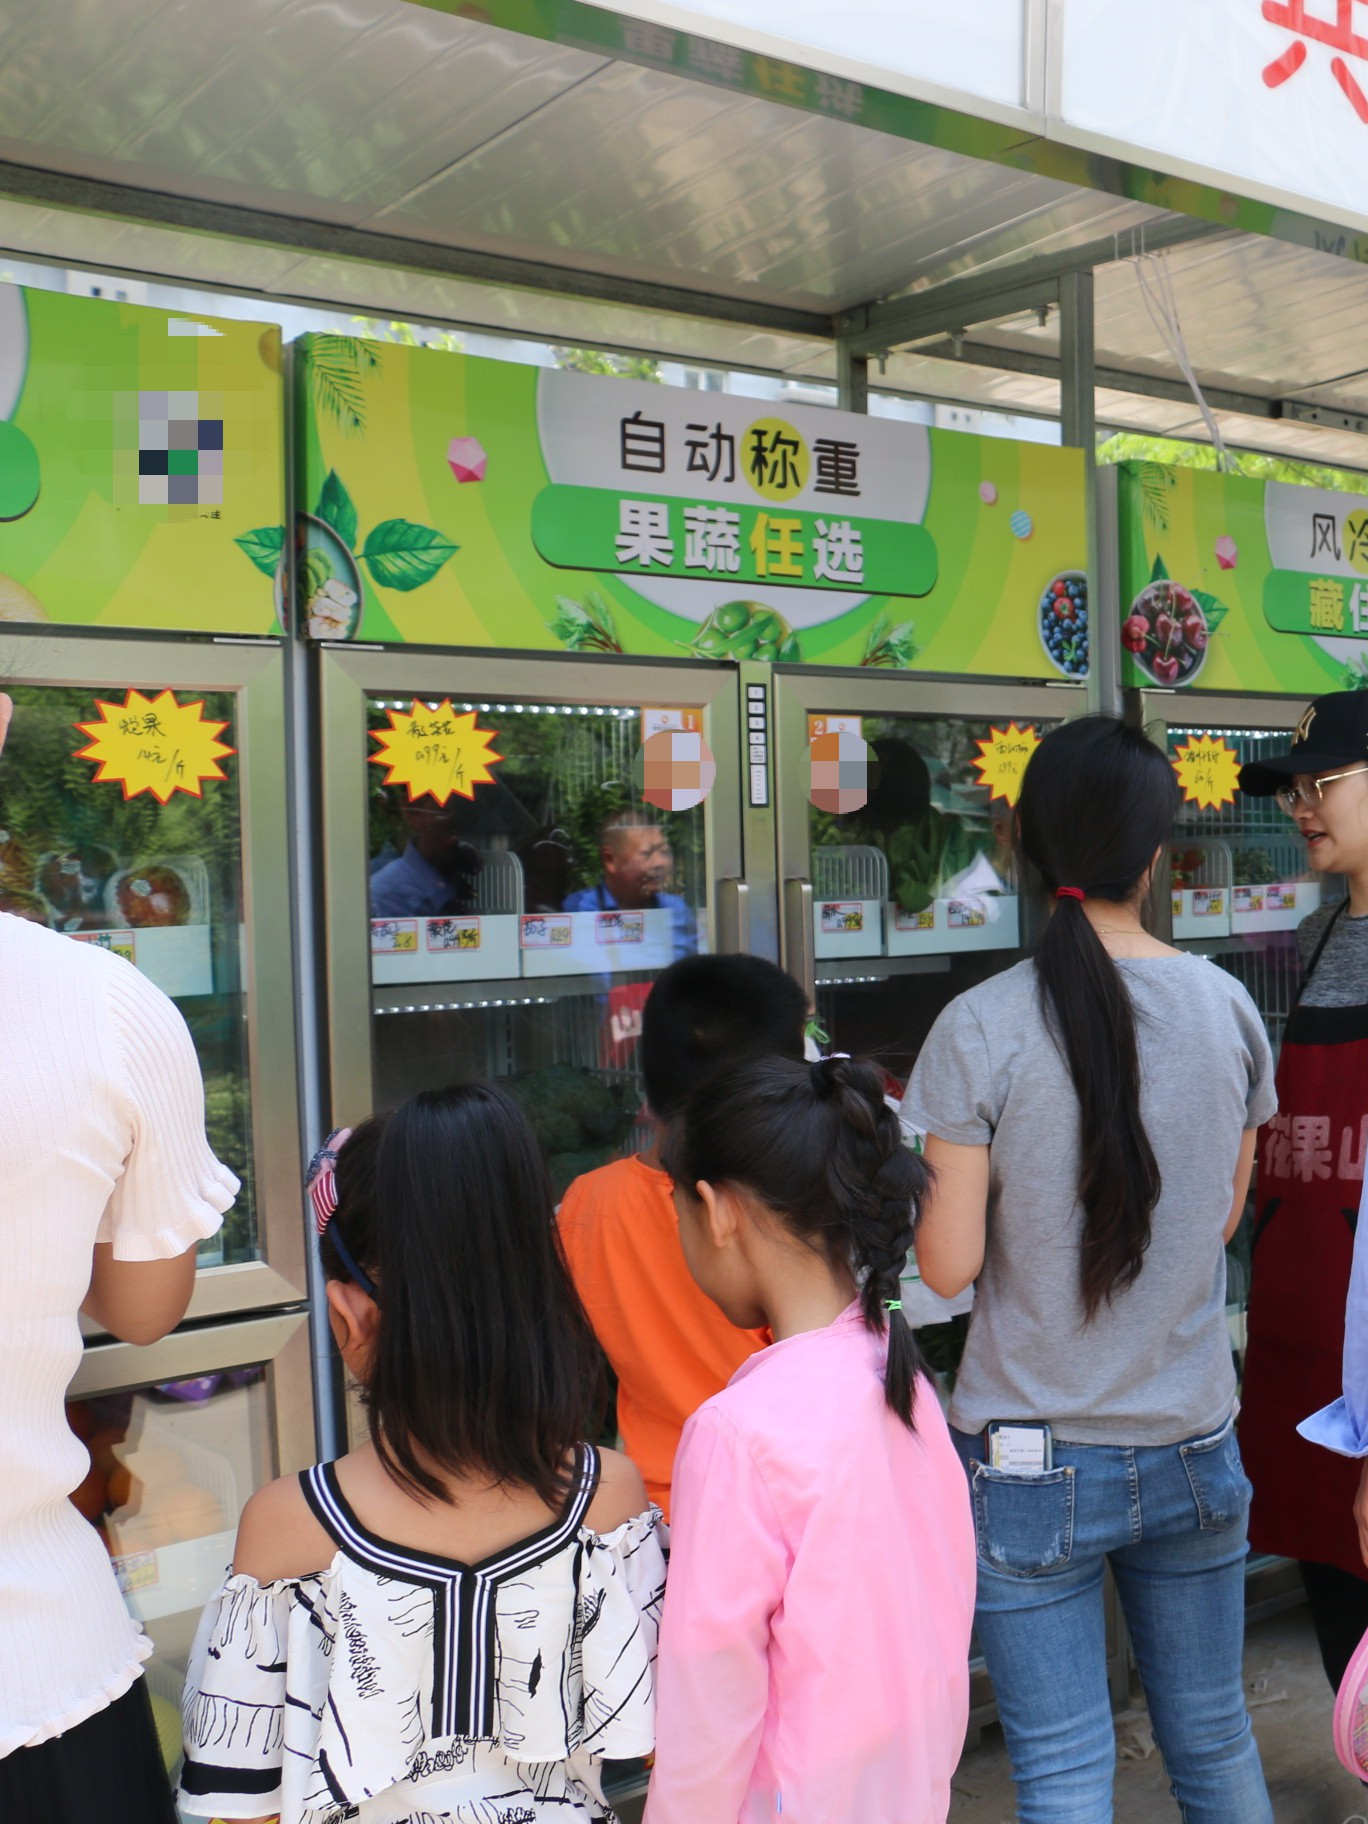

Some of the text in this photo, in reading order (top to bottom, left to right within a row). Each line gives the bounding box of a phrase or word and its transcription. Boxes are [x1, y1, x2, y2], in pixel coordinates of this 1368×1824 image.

[620, 410, 861, 497] 自动称重
[614, 499, 865, 584] 果蔬任选
[814, 721, 825, 736] 2
